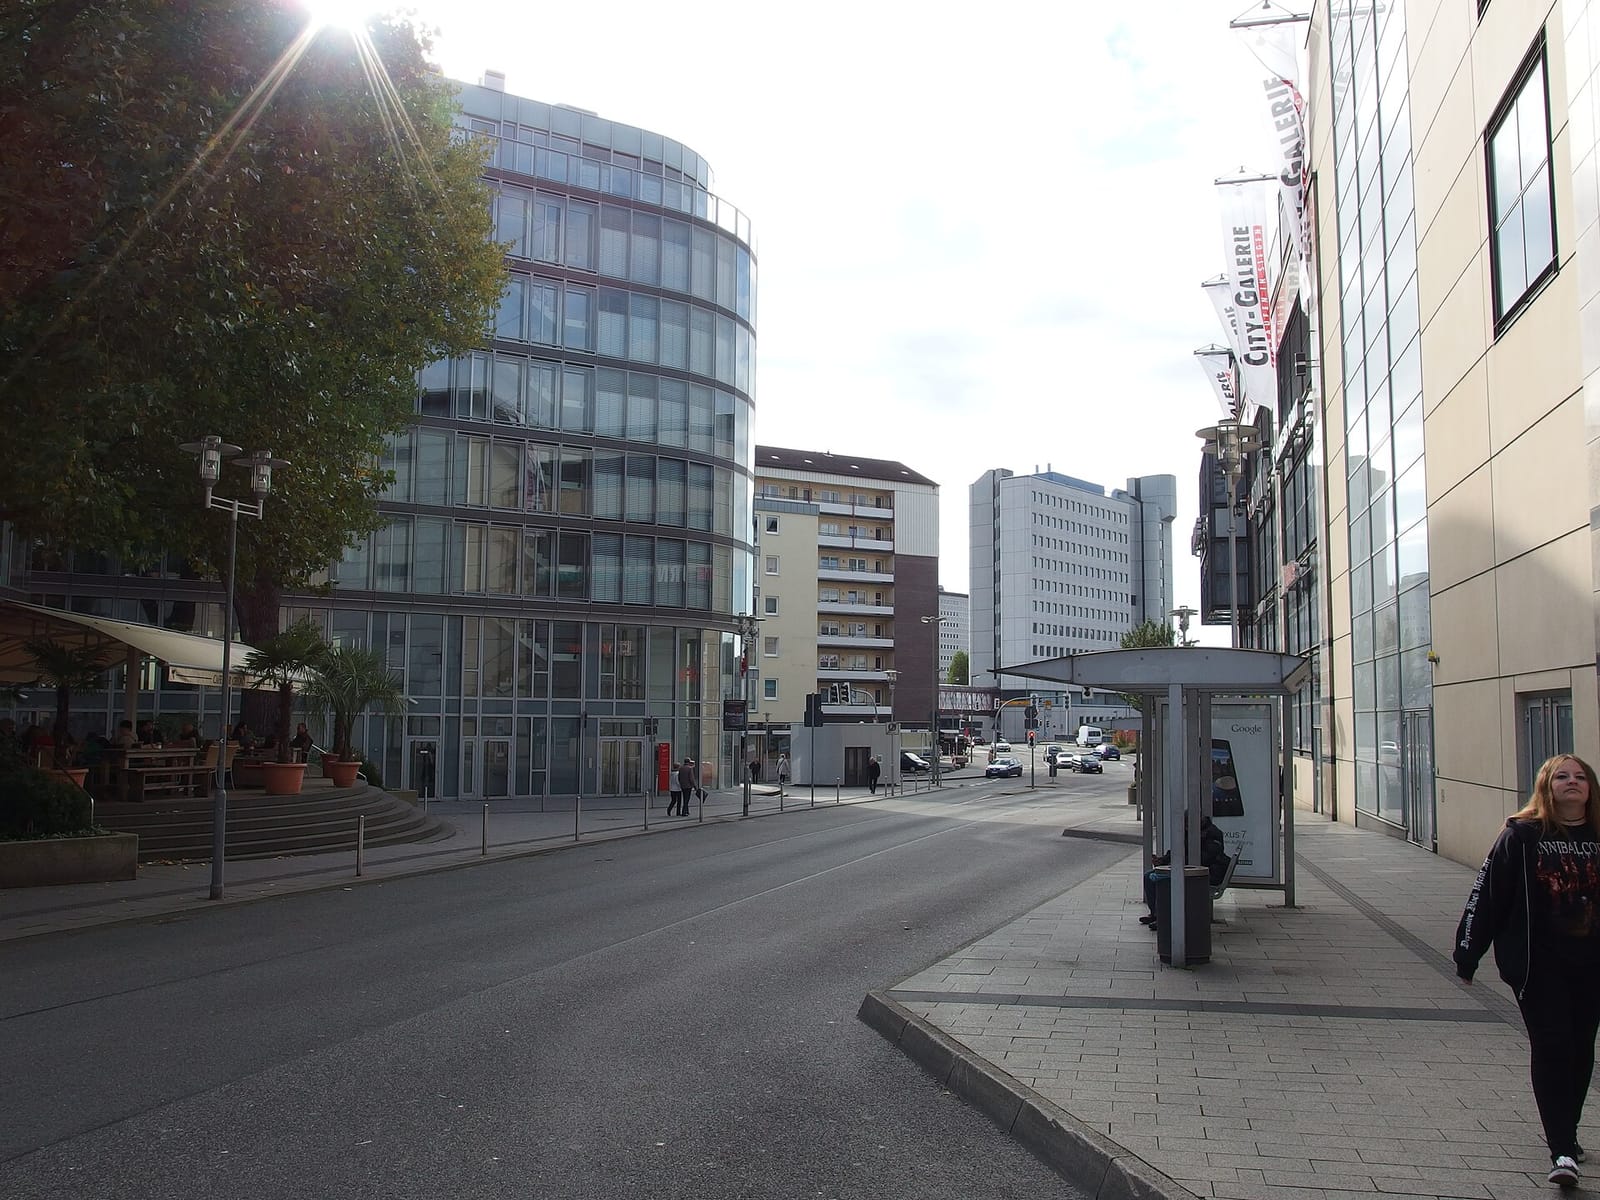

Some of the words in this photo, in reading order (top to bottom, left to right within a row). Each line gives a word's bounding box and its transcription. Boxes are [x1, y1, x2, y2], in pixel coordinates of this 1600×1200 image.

[1232, 225, 1270, 367] CITY-GALERIE
[1231, 723, 1262, 735] Google
[1224, 831, 1240, 839] xus
[1241, 830, 1247, 839] 7
